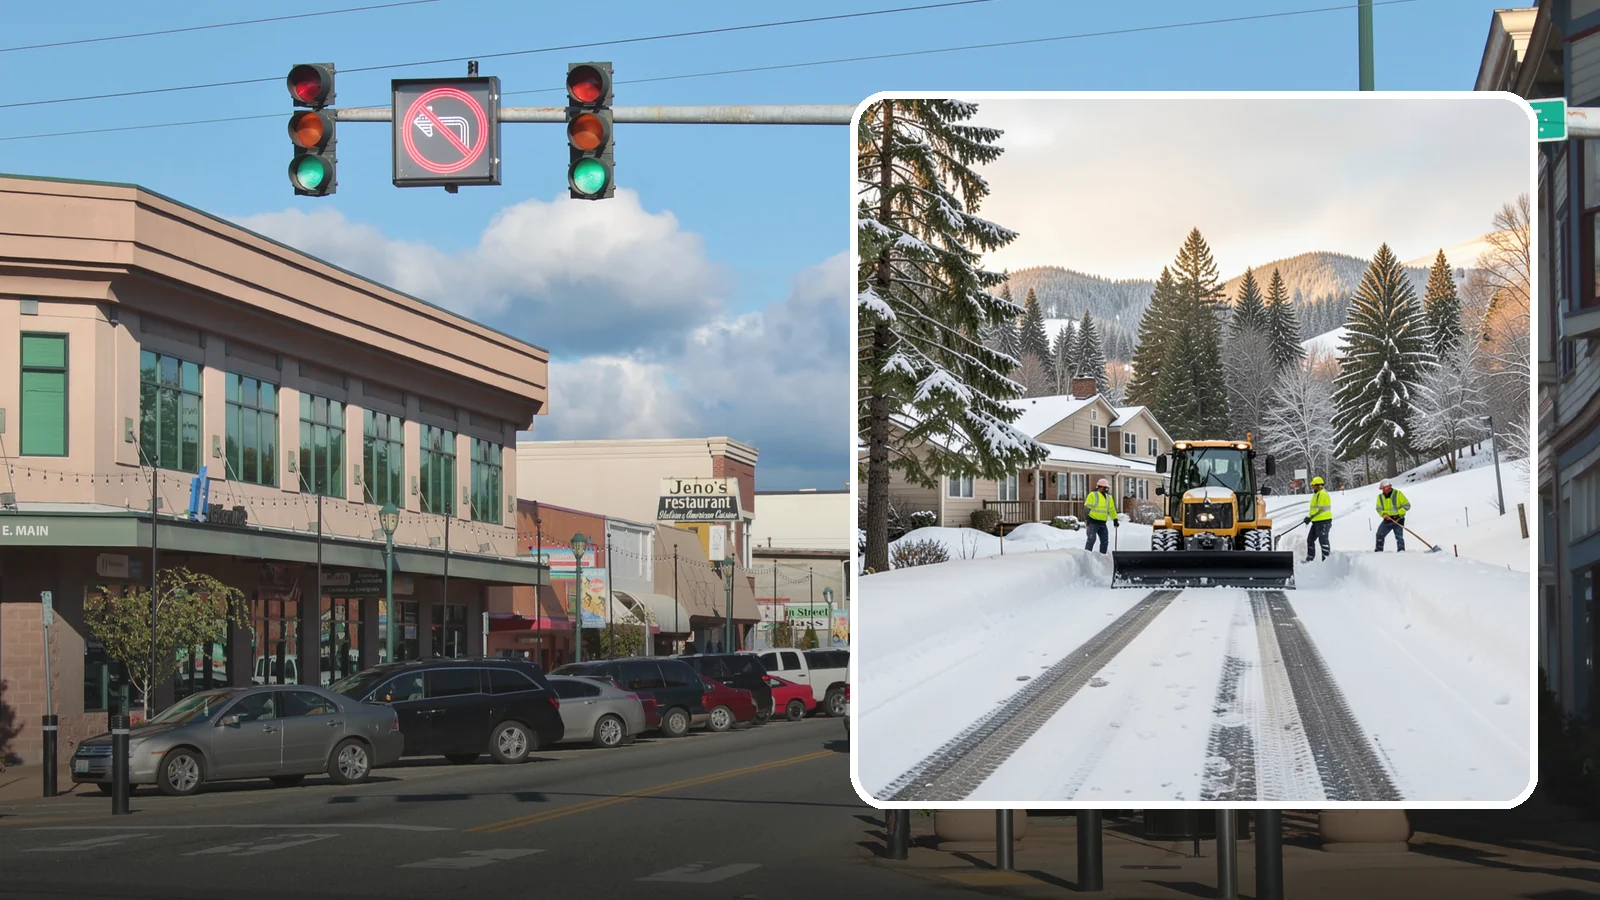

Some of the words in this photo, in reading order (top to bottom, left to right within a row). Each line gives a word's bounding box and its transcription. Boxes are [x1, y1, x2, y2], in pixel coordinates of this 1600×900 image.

[670, 480, 727, 494] Jeno's
[665, 496, 731, 509] restaurant
[658, 510, 681, 519] Italian
[686, 510, 714, 519] American
[715, 509, 737, 519] Cuisine
[2, 525, 13, 536] E.
[15, 525, 49, 537] MAIN
[797, 607, 828, 617] Street
